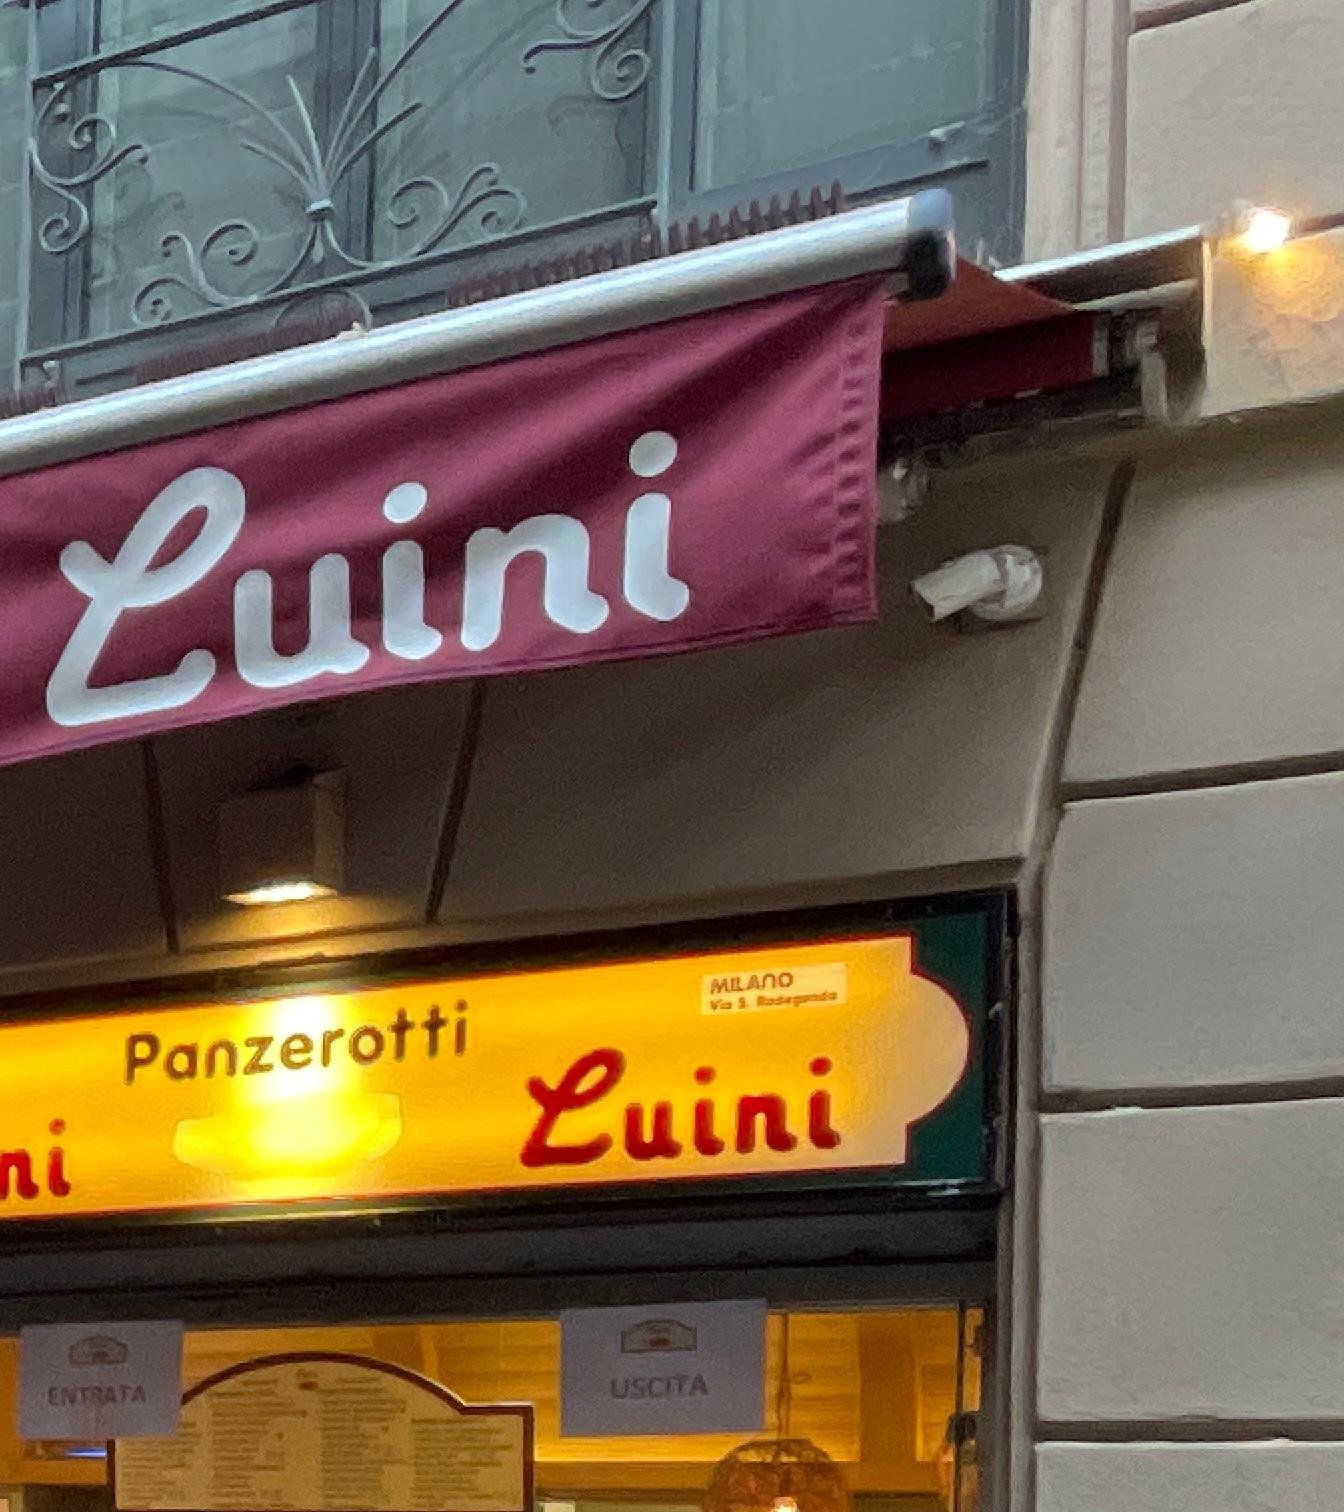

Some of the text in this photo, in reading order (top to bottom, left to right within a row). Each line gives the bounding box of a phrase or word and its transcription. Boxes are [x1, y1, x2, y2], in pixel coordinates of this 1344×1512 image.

[46, 430, 690, 727] Luini
[710, 972, 794, 994] MILANO
[124, 999, 470, 1086] Panzerotti
[519, 1047, 841, 1168] Luini
[48, 1384, 146, 1406] ENTRATA
[611, 1373, 710, 1400] USCITA
